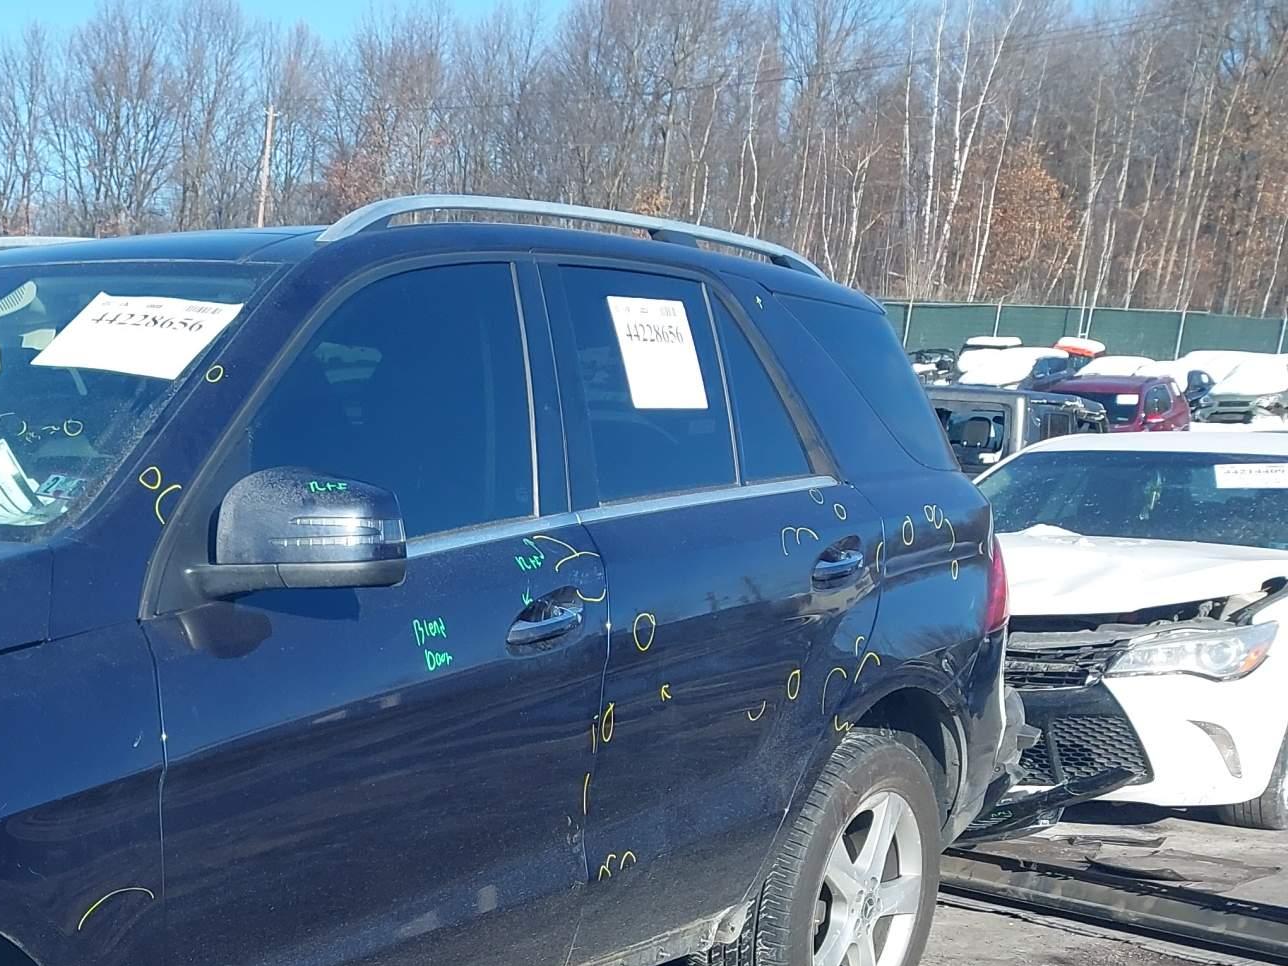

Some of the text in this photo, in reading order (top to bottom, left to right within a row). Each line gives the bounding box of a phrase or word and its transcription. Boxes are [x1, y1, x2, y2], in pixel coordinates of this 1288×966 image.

[92, 312, 205, 332] 44228656
[626, 323, 684, 343] 44228656
[425, 649, 452, 671] Door
